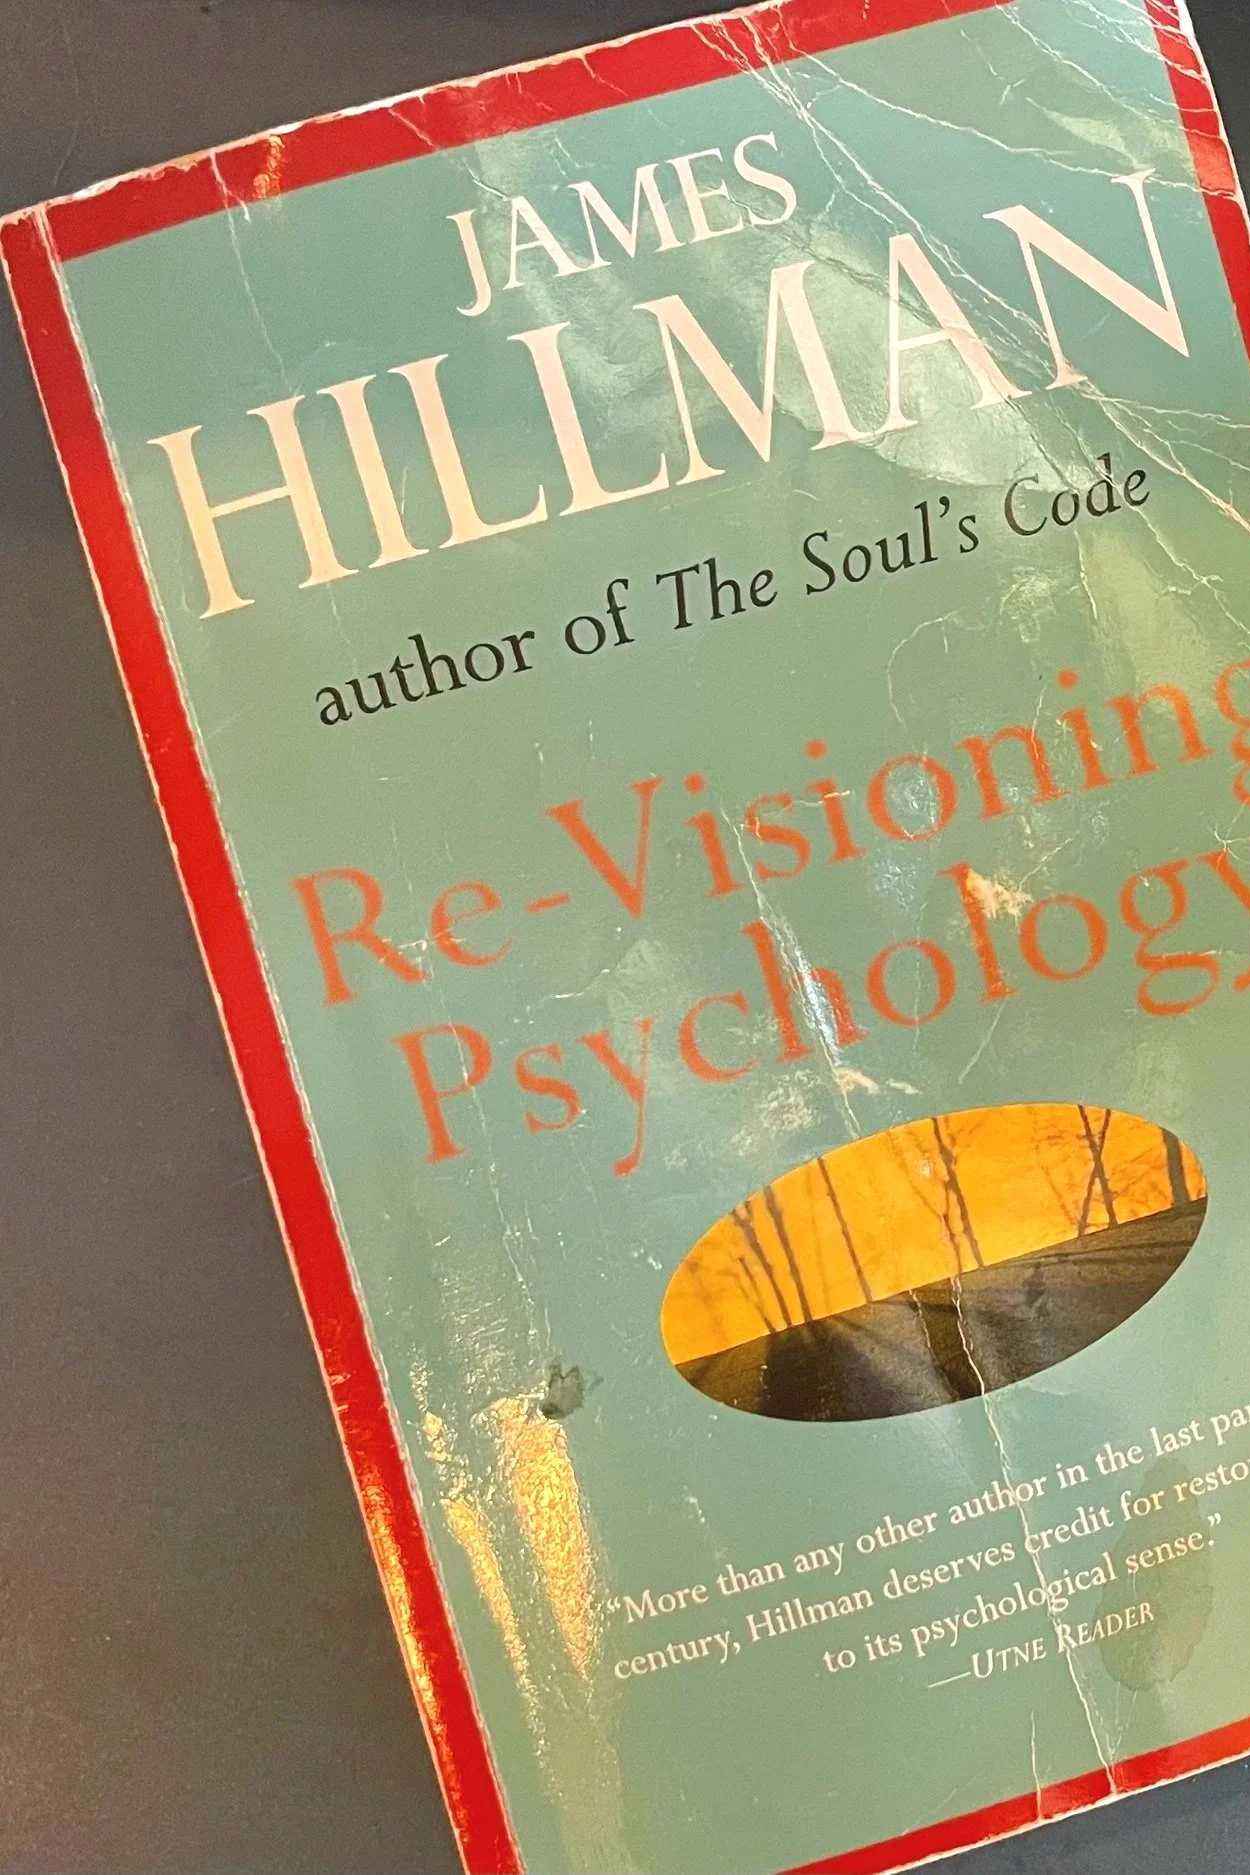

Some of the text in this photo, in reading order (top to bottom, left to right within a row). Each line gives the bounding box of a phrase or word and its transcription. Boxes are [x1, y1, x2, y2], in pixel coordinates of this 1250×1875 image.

[446, 132, 798, 317] JAMES
[148, 169, 1190, 619] HILLMAN
[315, 453, 1151, 724] author of The Soul's Code
[614, 1630, 741, 1679] century,
[745, 1588, 874, 1644] Hillman
[883, 1541, 1015, 1600] deserves
[1024, 1506, 1114, 1554] credit
[1121, 1489, 1164, 1521] for
[717, 1565, 785, 1596] than
[794, 1543, 845, 1576] any
[856, 1515, 937, 1553] other
[949, 1475, 1047, 1525] author
[1056, 1463, 1088, 1490] in
[1095, 1443, 1144, 1476] the
[1151, 1419, 1204, 1457] last
[823, 1648, 856, 1673] to
[864, 1632, 901, 1662] its
[911, 1552, 1115, 1657] psychological
[1056, 1602, 1154, 1653] READER
